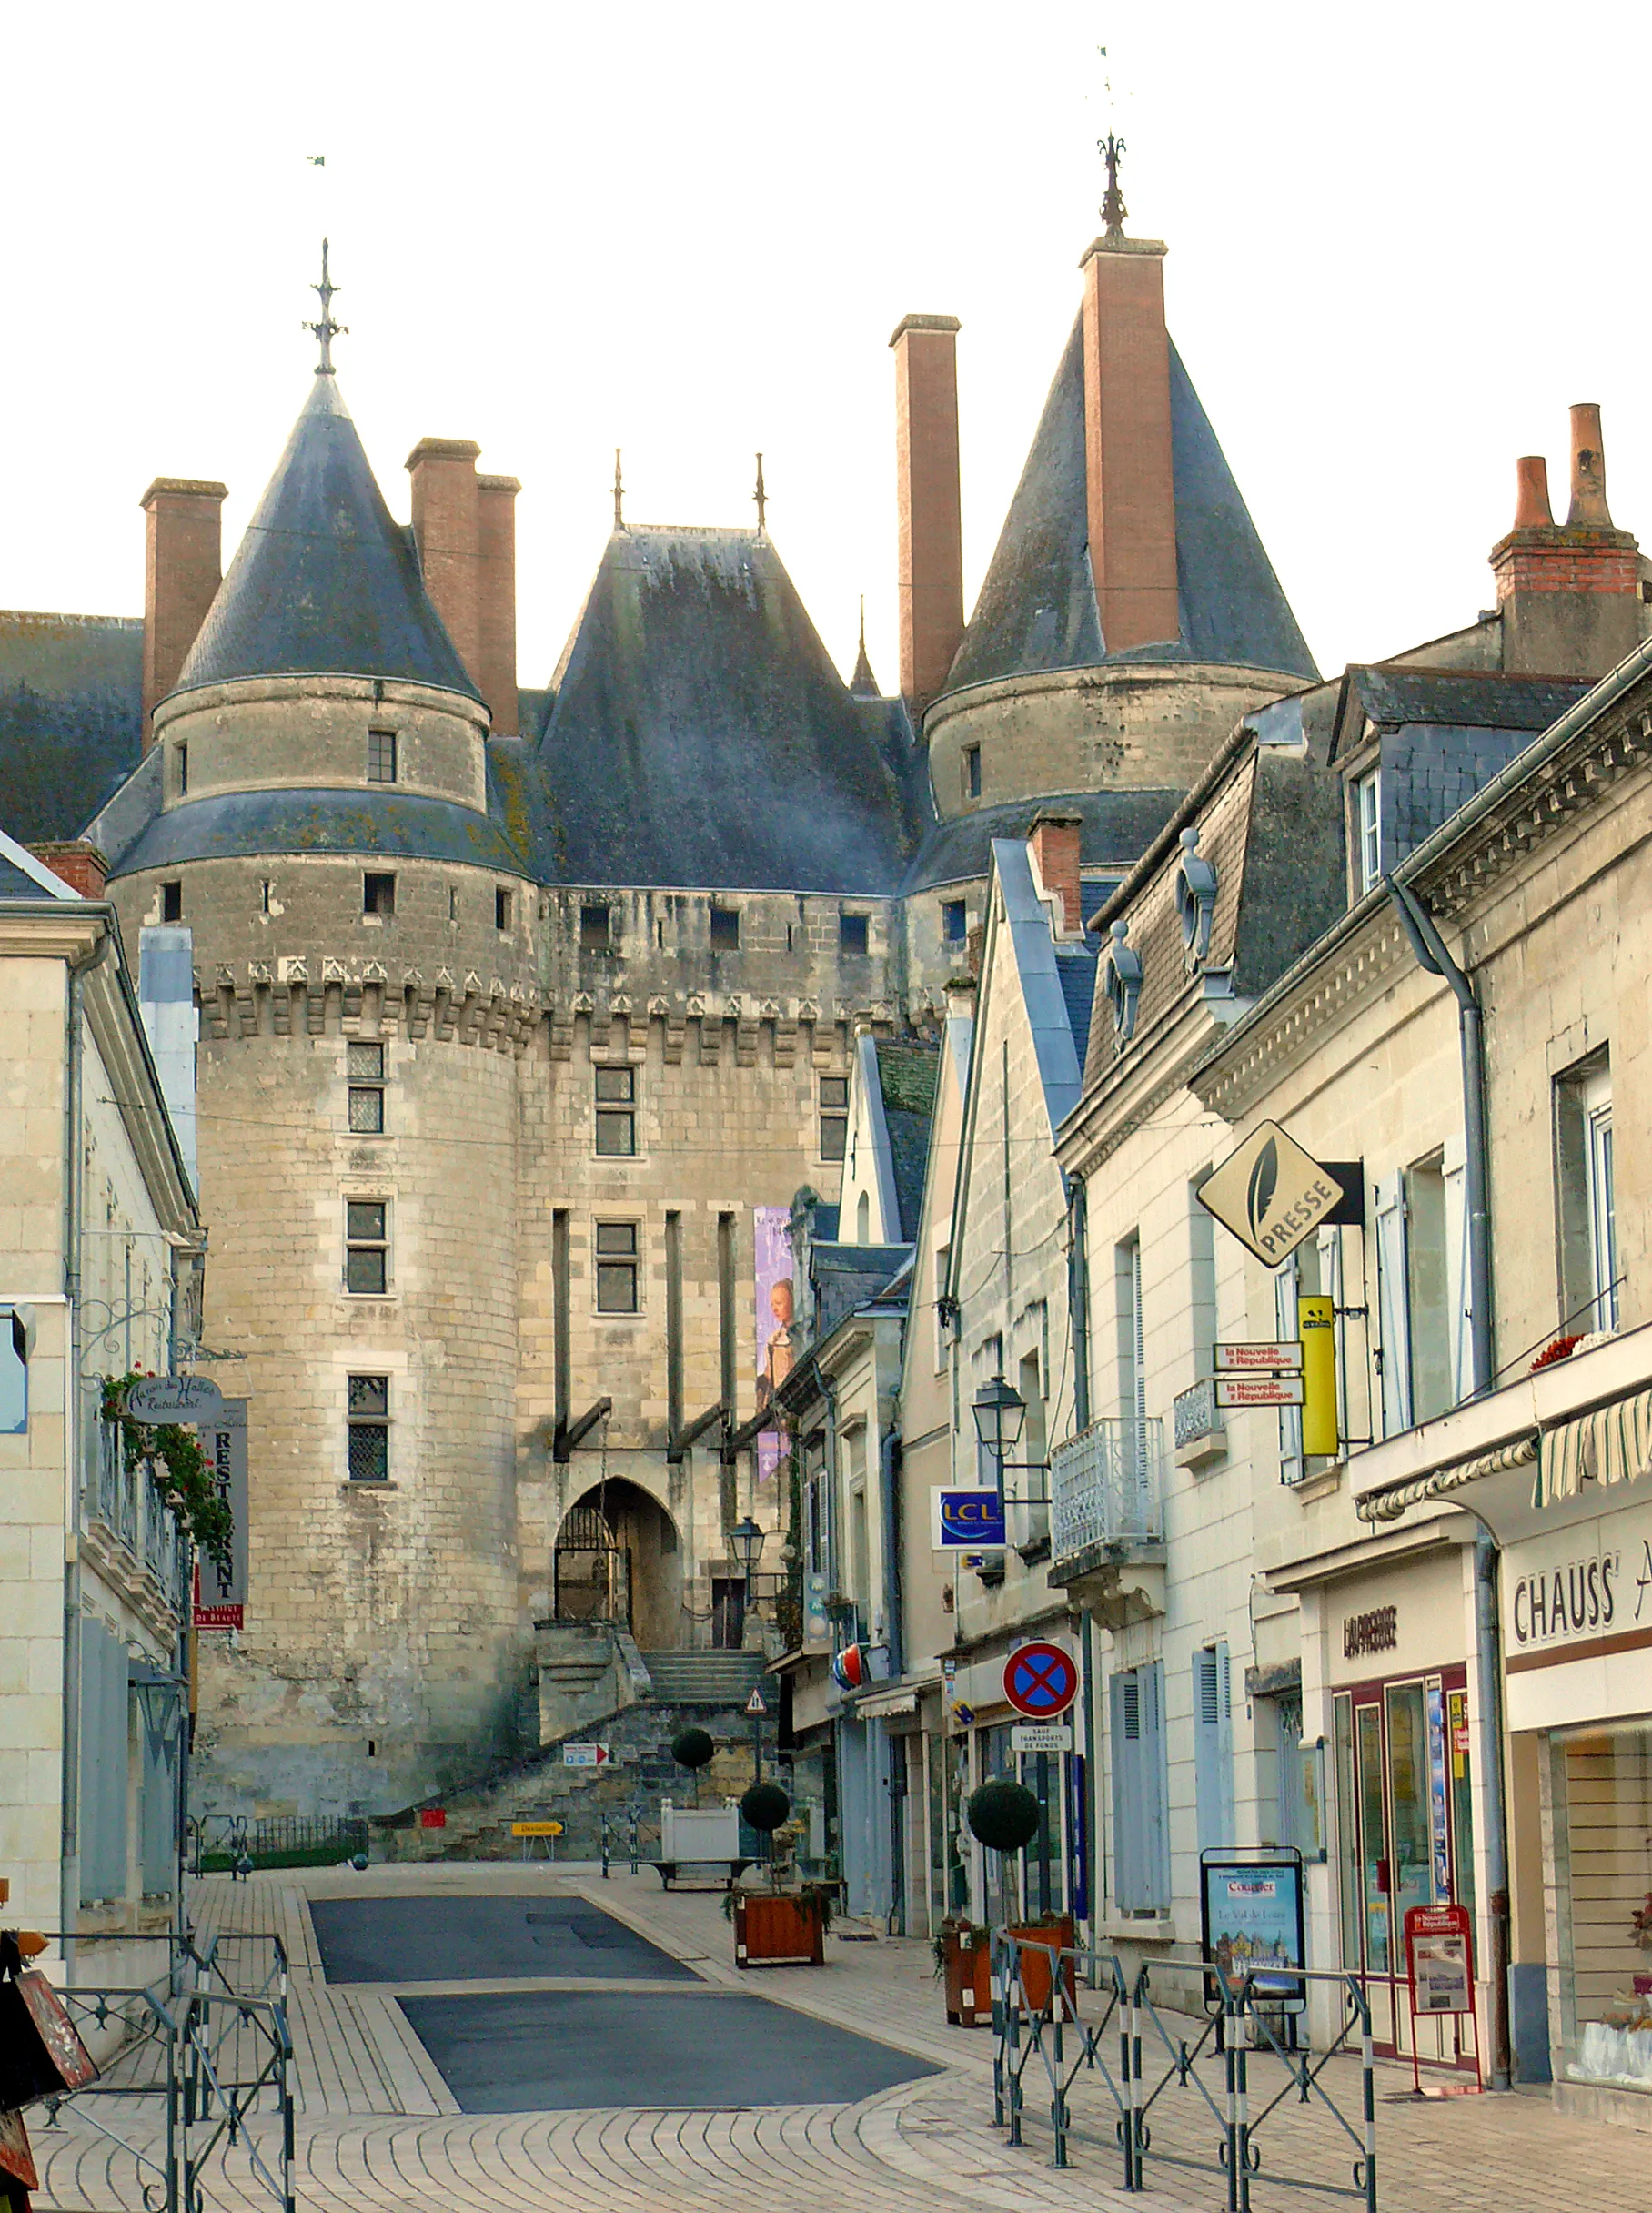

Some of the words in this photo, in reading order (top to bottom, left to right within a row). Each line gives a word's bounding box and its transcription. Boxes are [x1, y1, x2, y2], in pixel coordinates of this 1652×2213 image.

[1260, 1180, 1332, 1254] PRESSE
[1236, 1347, 1279, 1356] Nouvelle
[177, 1376, 216, 1402] Halles
[1237, 1382, 1280, 1391] Nouvelle
[216, 1432, 234, 1599] RESTARANT
[944, 1504, 997, 1521] LCL
